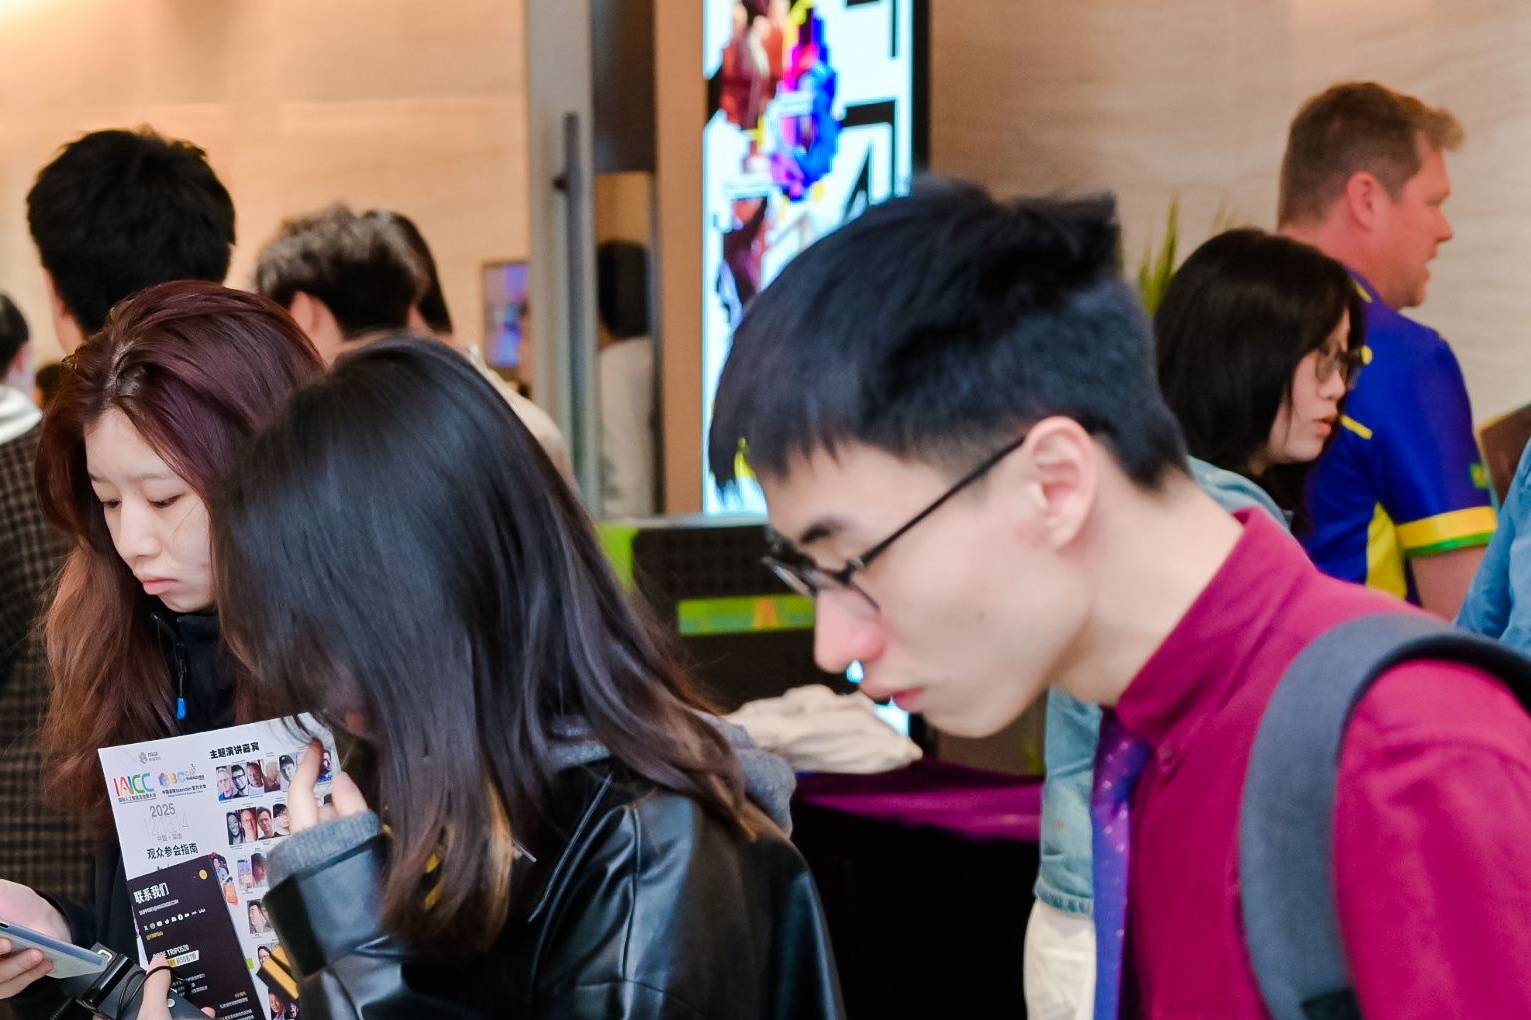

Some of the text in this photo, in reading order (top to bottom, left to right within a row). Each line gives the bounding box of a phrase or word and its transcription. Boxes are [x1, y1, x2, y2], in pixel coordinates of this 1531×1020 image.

[210, 742, 260, 759] 主题演讲嘉宾
[113, 772, 155, 797] IAICC
[150, 803, 176, 817] 2025
[147, 843, 199, 860] 观众参会指南
[133, 882, 170, 904] 联系我们
